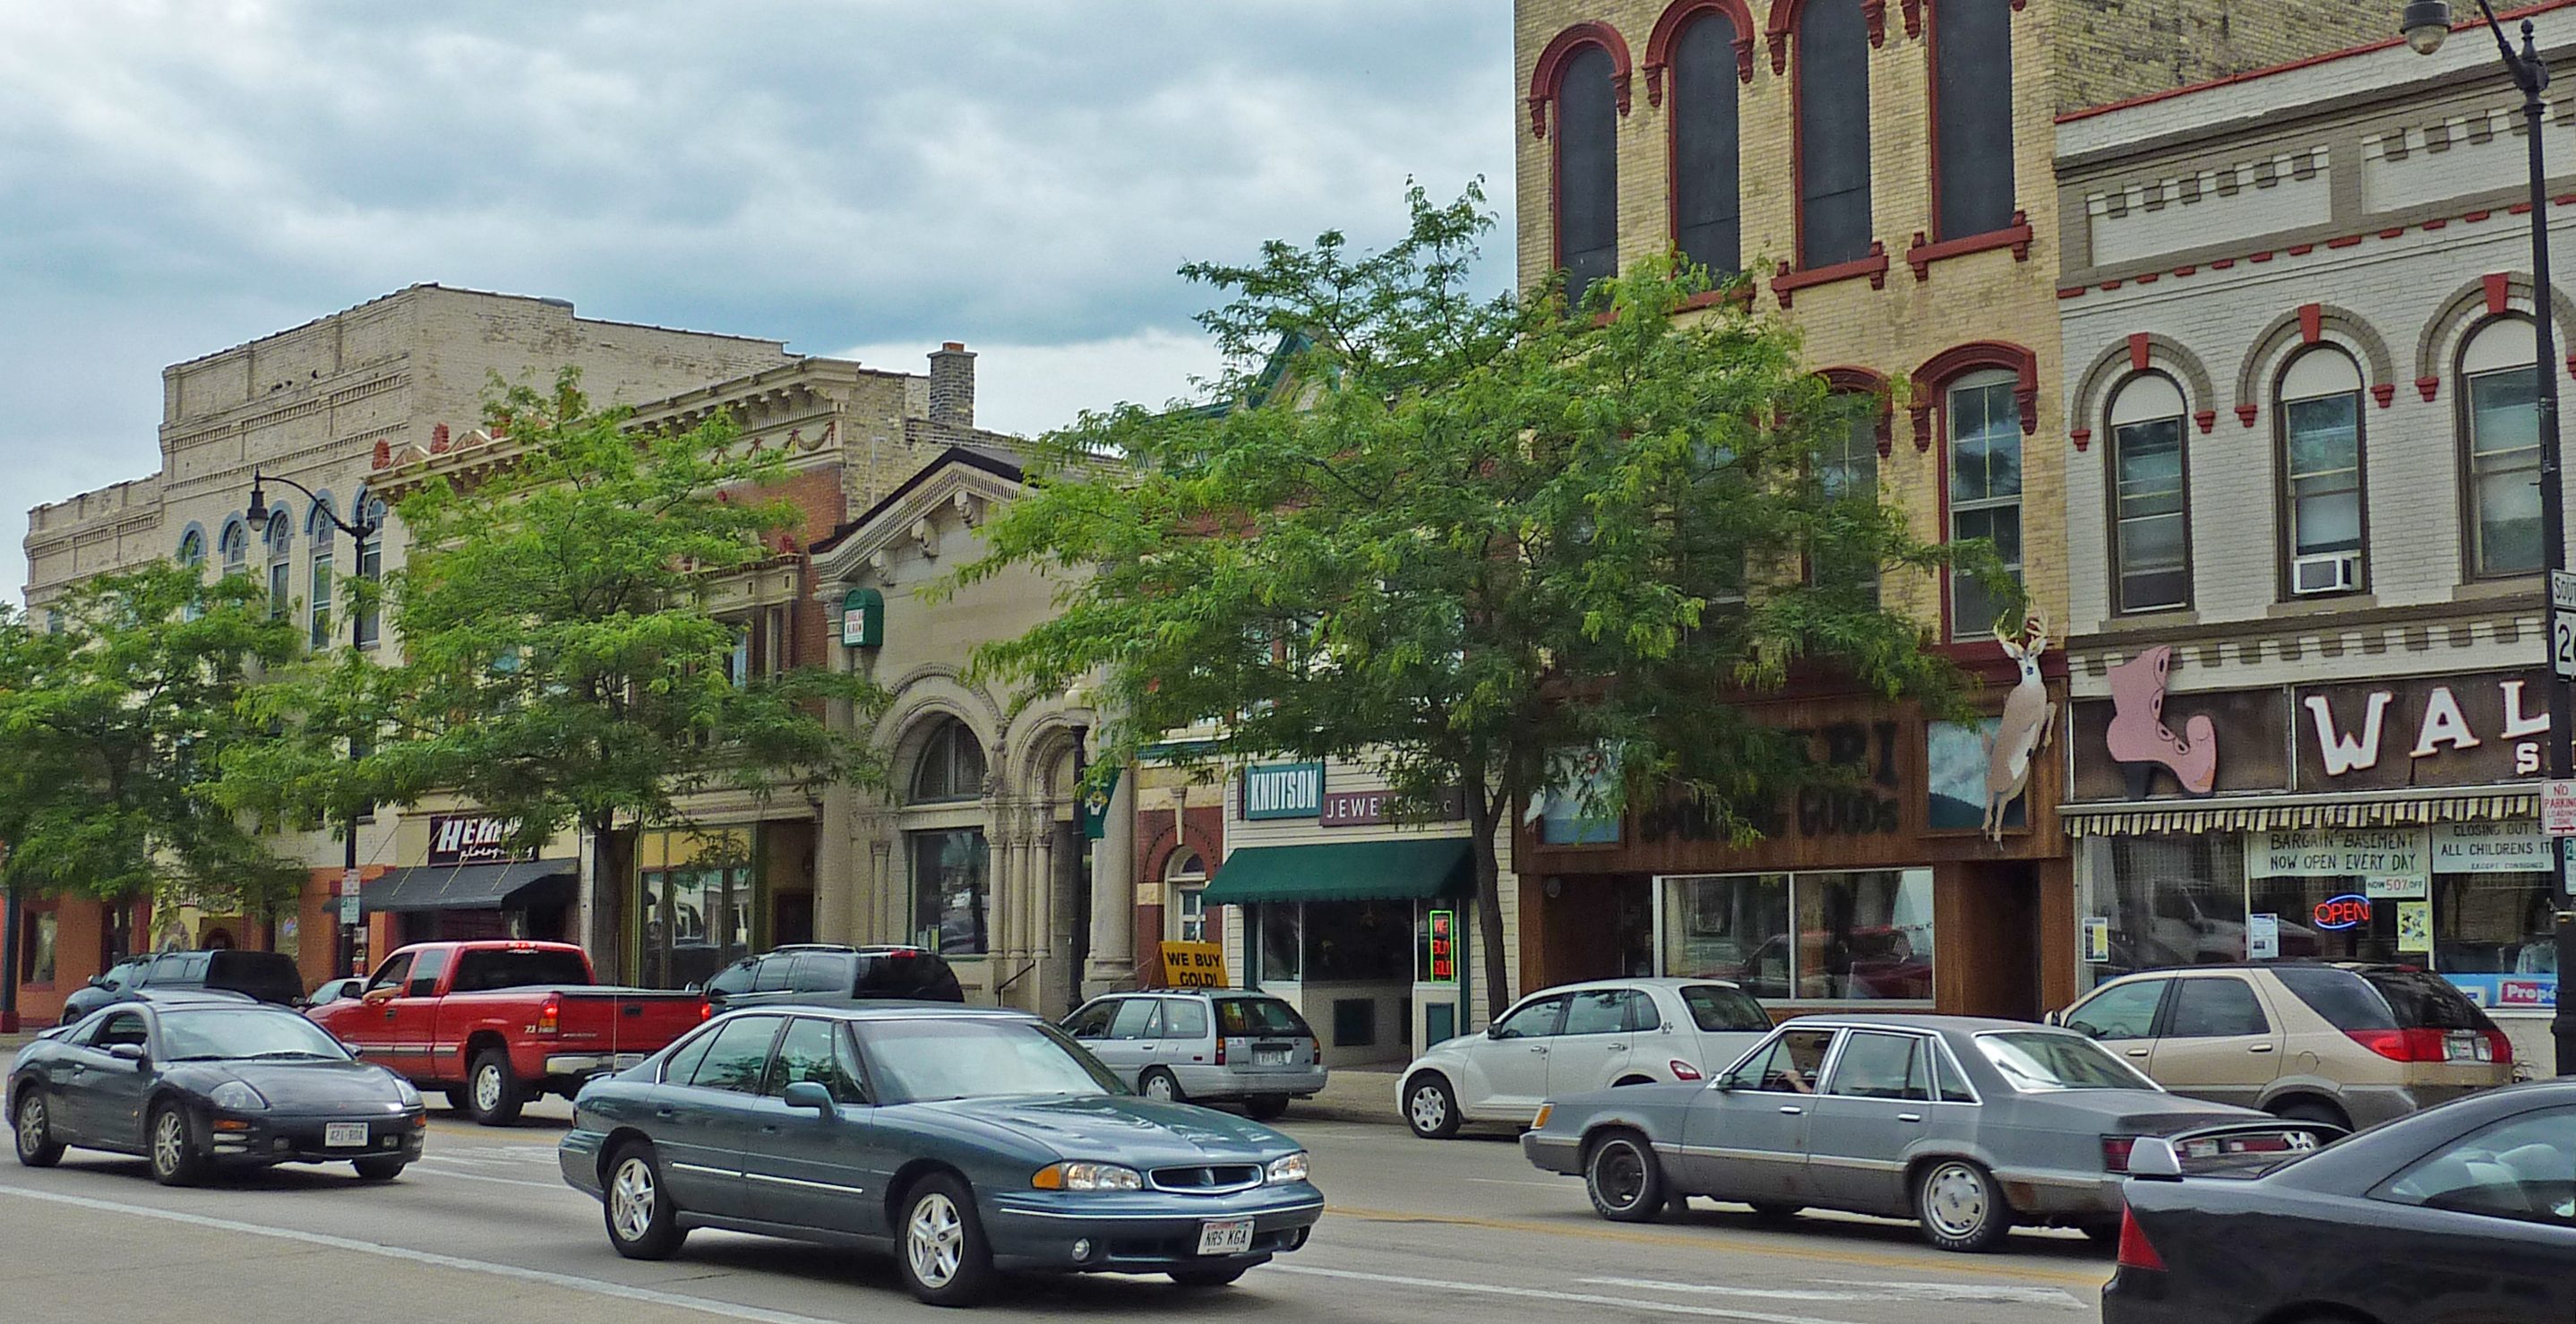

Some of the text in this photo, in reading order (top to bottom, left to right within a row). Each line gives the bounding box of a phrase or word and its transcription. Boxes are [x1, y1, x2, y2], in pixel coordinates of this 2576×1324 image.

[2558, 623, 2576, 664] 2
[1250, 769, 1318, 812] KNUTSON
[2554, 785, 2569, 796] NO
[2453, 823, 2501, 837] CLOSING
[2506, 822, 2529, 836] OUT
[2271, 832, 2416, 850] BARGAIN BASEMENT
[2441, 843, 2463, 856] ALL
[2469, 841, 2534, 855] CHILDRENS
[2271, 854, 2417, 871] NOW OPEN EVERY DAY
[2367, 878, 2423, 891] NOW 50% OFF
[2314, 902, 2371, 923] OPEN
[1167, 951, 1220, 967] WE BUY
[1180, 971, 1218, 988] GOLD!
[1206, 1229, 1248, 1247] NRS KGA
